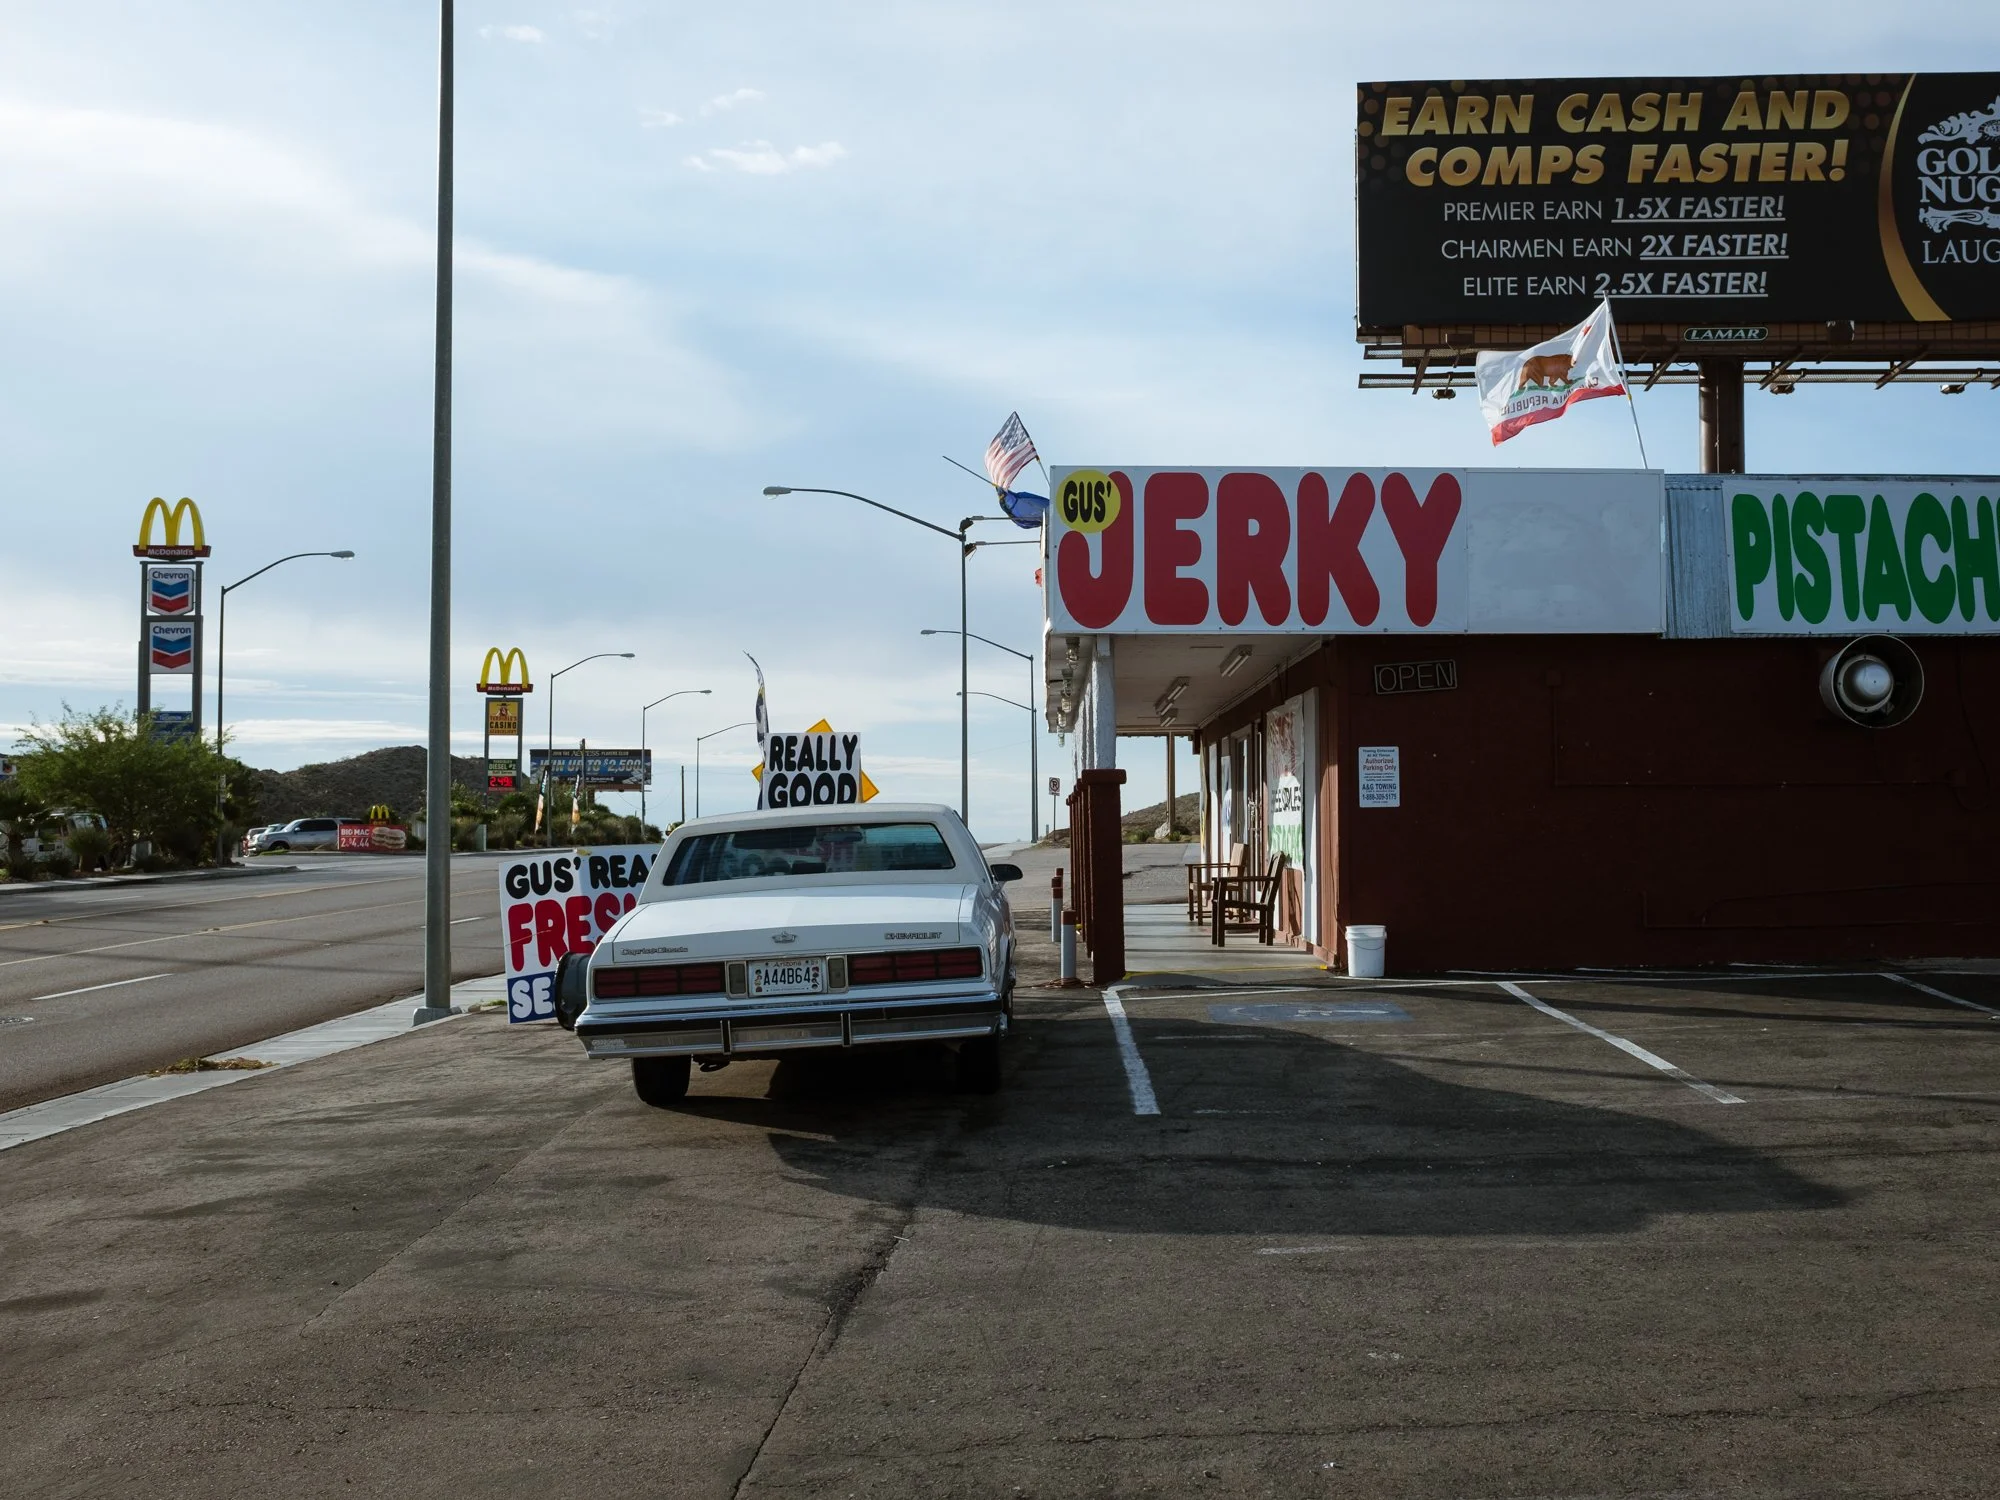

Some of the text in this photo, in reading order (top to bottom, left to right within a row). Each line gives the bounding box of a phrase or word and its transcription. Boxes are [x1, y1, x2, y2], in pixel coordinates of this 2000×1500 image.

[1381, 89, 1851, 136] EARN CASH AND
[1405, 139, 1850, 187] COMPS FASTER!
[1443, 195, 1785, 221] PREMIER EARN 1.5X FASTER!
[1441, 232, 1789, 258] CHAIRMEN EARN 2X FASTER!
[1463, 271, 1768, 296] ELITE EARN 2.5X FASTER!
[1690, 329, 1760, 340] LAMAR
[1063, 479, 1113, 523] GUS'
[147, 548, 194, 556] McDonald's
[1057, 470, 1462, 630] JERKY
[1732, 491, 2000, 624] PISTACH
[151, 570, 189, 580] Chevron
[152, 625, 192, 635] Chevron
[1379, 663, 1452, 692] OPEN
[489, 721, 518, 730] CASINO
[769, 735, 858, 772] REALLY
[767, 773, 858, 809] GOOD
[341, 828, 370, 836] BIG MAC
[505, 854, 658, 900] GUS' REA
[507, 892, 637, 973] FRES
[884, 931, 943, 940] CHEVROLET
[763, 966, 811, 986] A44B64
[772, 960, 803, 968] Arizona
